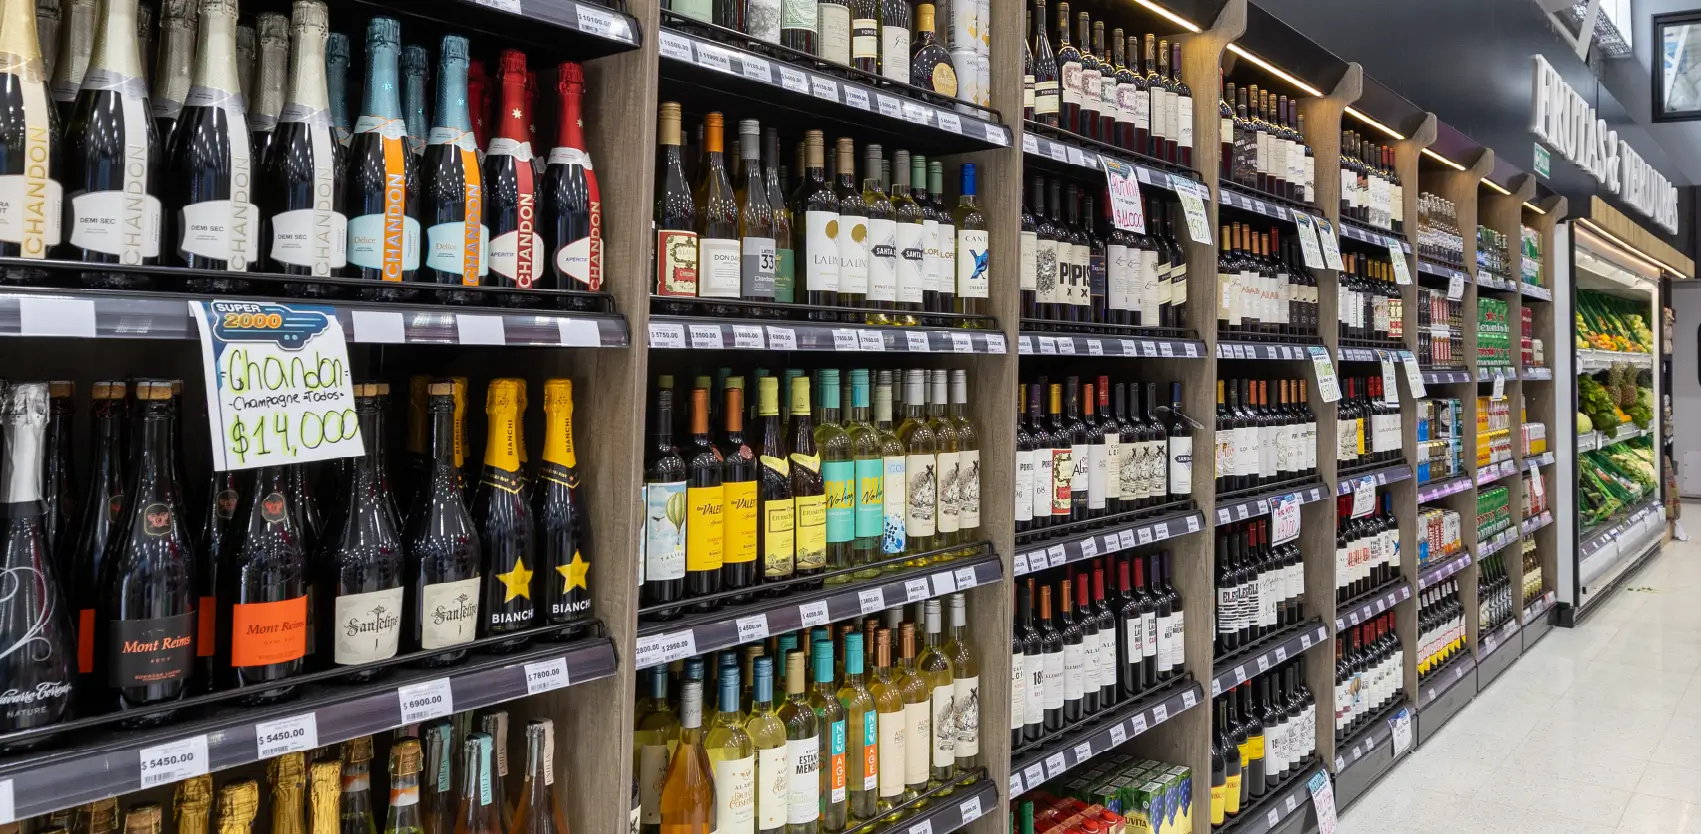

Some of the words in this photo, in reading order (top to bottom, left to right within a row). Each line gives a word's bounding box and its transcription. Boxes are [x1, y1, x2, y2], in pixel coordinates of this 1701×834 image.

[1533, 54, 1607, 184] FRUTAS
[1606, 130, 1621, 194] &
[24, 126, 47, 255] CHANDON
[124, 145, 146, 266] CHANDON
[80, 217, 98, 225] DEMI
[100, 217, 116, 225] SEC
[231, 156, 249, 272] CHANDON
[315, 166, 333, 276] CHANDON
[191, 224, 208, 232] DEMI
[385, 173, 404, 280] CHANDON
[464, 183, 480, 283] CHANDON
[354, 235, 376, 244] Délice
[517, 192, 534, 289] CHANDON
[590, 201, 601, 291] CHANDON
[876, 247, 893, 255] SANTA
[761, 254, 774, 270] 33
[814, 254, 827, 265] LA
[841, 257, 854, 267] LA
[216, 303, 261, 313] SUPER
[223, 313, 283, 329] 2000
[230, 409, 360, 464] $14,000
[246, 623, 280, 636] Mont
[281, 621, 306, 632] Reims
[122, 638, 158, 654] Mont
[161, 635, 192, 651] Reims
[666, 640, 689, 651] 2950.00
[532, 668, 560, 679] 7800.00
[403, 702, 408, 710] $
[409, 695, 442, 708] 6900.00
[6, 705, 48, 718] NATURE
[258, 736, 265, 746] $
[266, 728, 305, 743] 5450.00
[141, 760, 148, 770] $
[149, 752, 194, 769] 5450.00
[1125, 816, 1147, 829] UVITA
